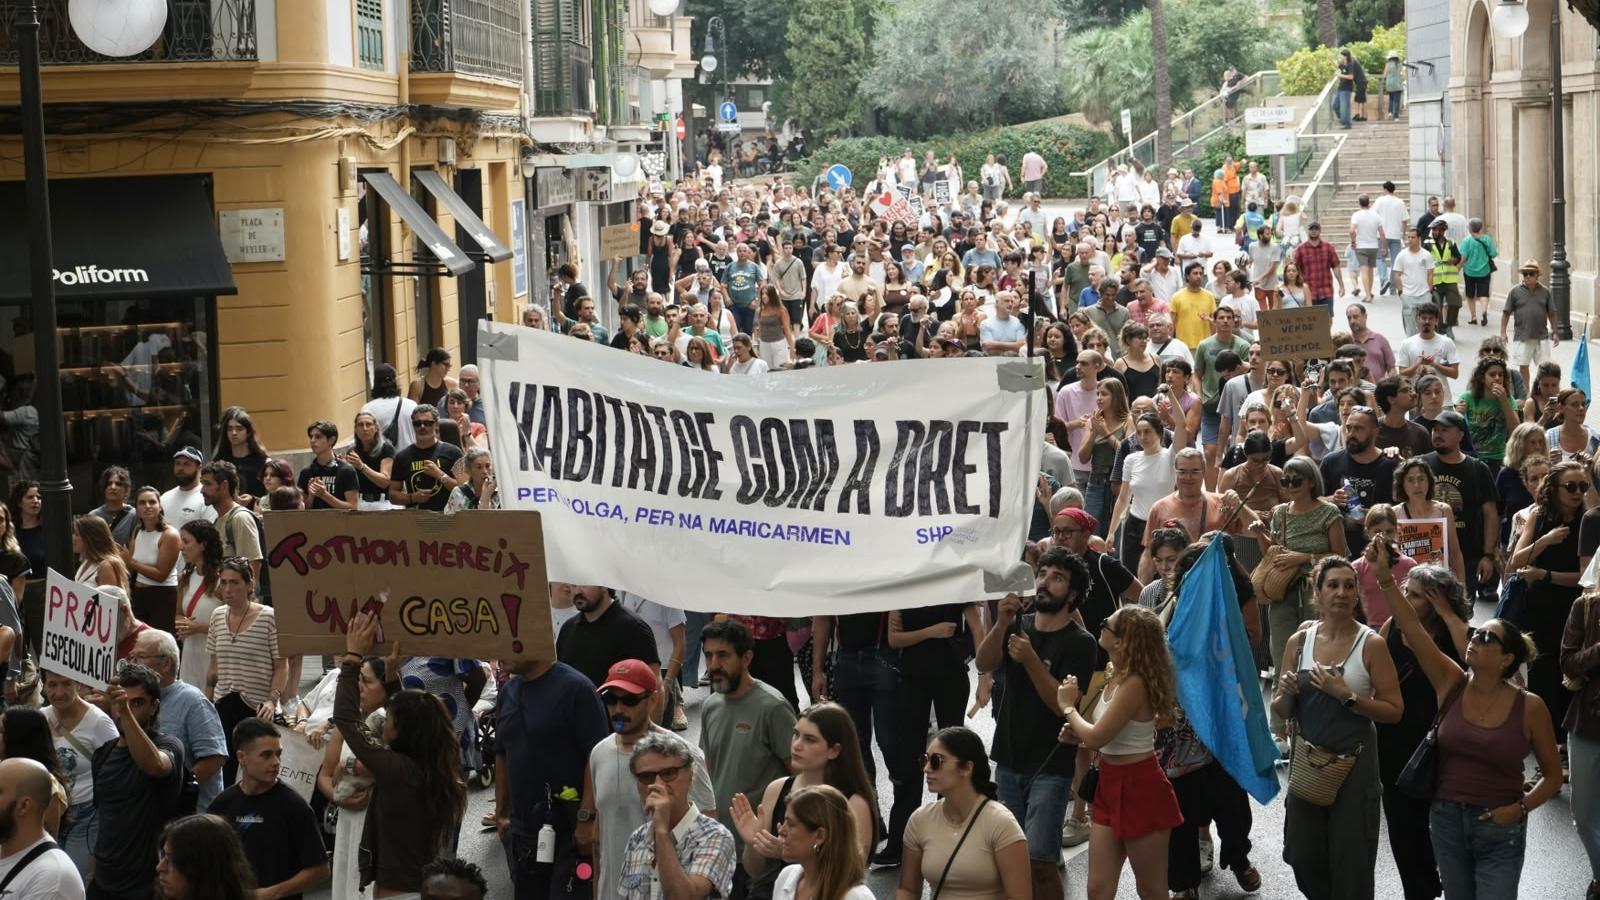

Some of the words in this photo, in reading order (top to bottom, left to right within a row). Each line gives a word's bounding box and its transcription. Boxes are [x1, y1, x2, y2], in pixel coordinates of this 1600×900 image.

[248, 231, 256, 240] DE
[1282, 323, 1313, 333] VENDE
[1270, 342, 1321, 355] DEFIENDE
[509, 381, 723, 501] HABITATGE
[729, 415, 840, 512] COM
[837, 419, 881, 515] A
[884, 420, 1009, 519] DRET
[517, 487, 560, 503] PER
[635, 507, 674, 526] PER
[679, 512, 703, 531] NA
[709, 517, 850, 546] MARICARMEN
[268, 532, 410, 576] TOTHOM
[280, 765, 314, 785] ENTE
